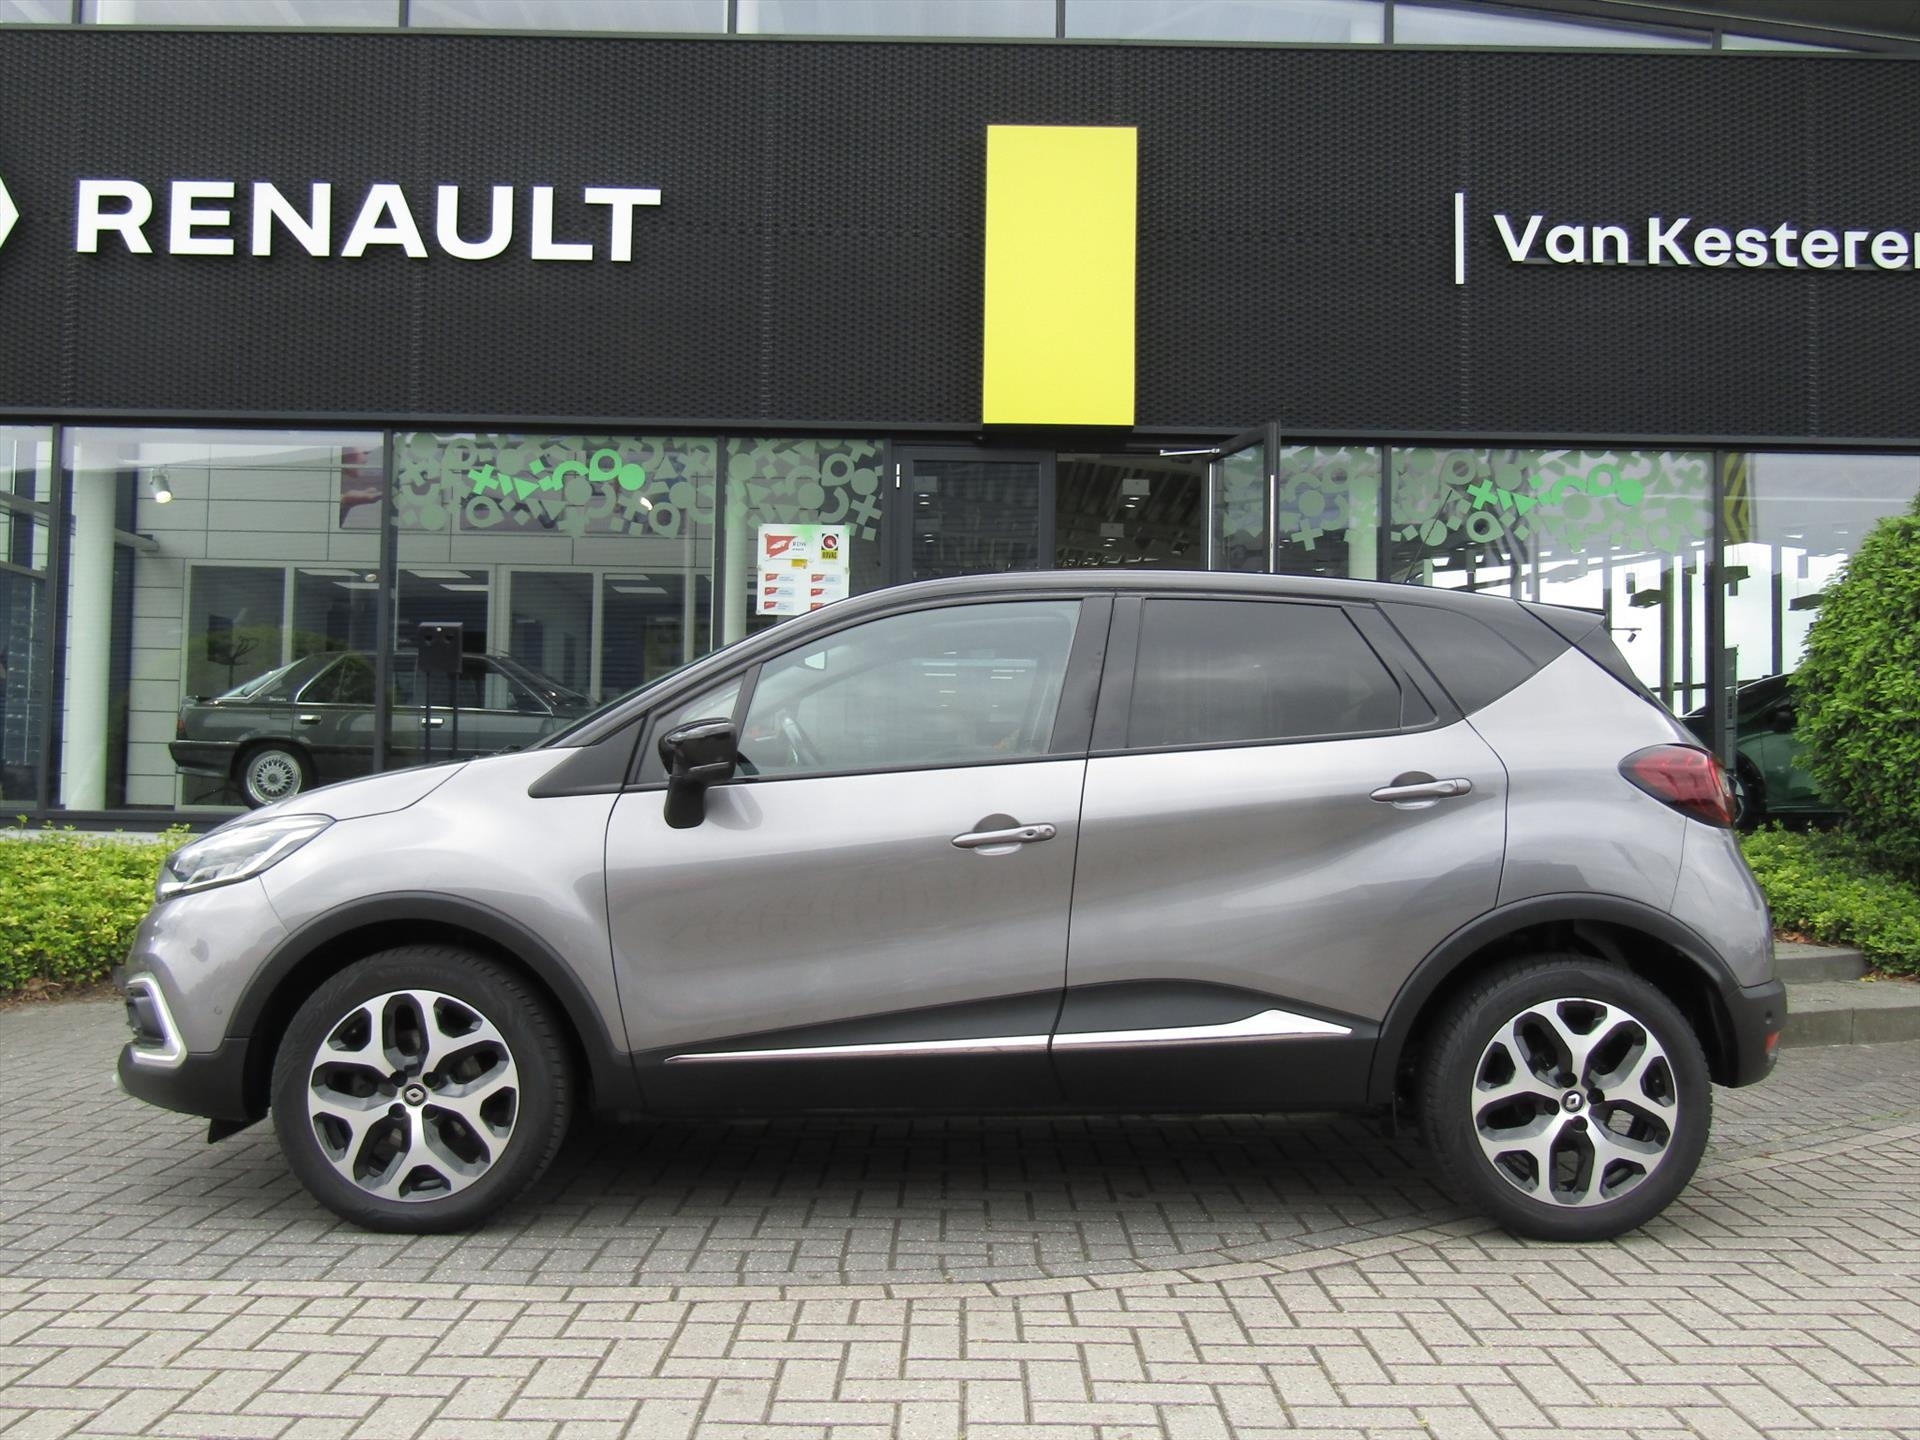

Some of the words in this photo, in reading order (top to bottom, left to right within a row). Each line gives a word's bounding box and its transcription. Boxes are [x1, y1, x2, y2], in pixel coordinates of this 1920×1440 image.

[76, 179, 661, 262] RENAULT
[1493, 214, 1630, 264] Van
[1648, 217, 1920, 270] Kestere
